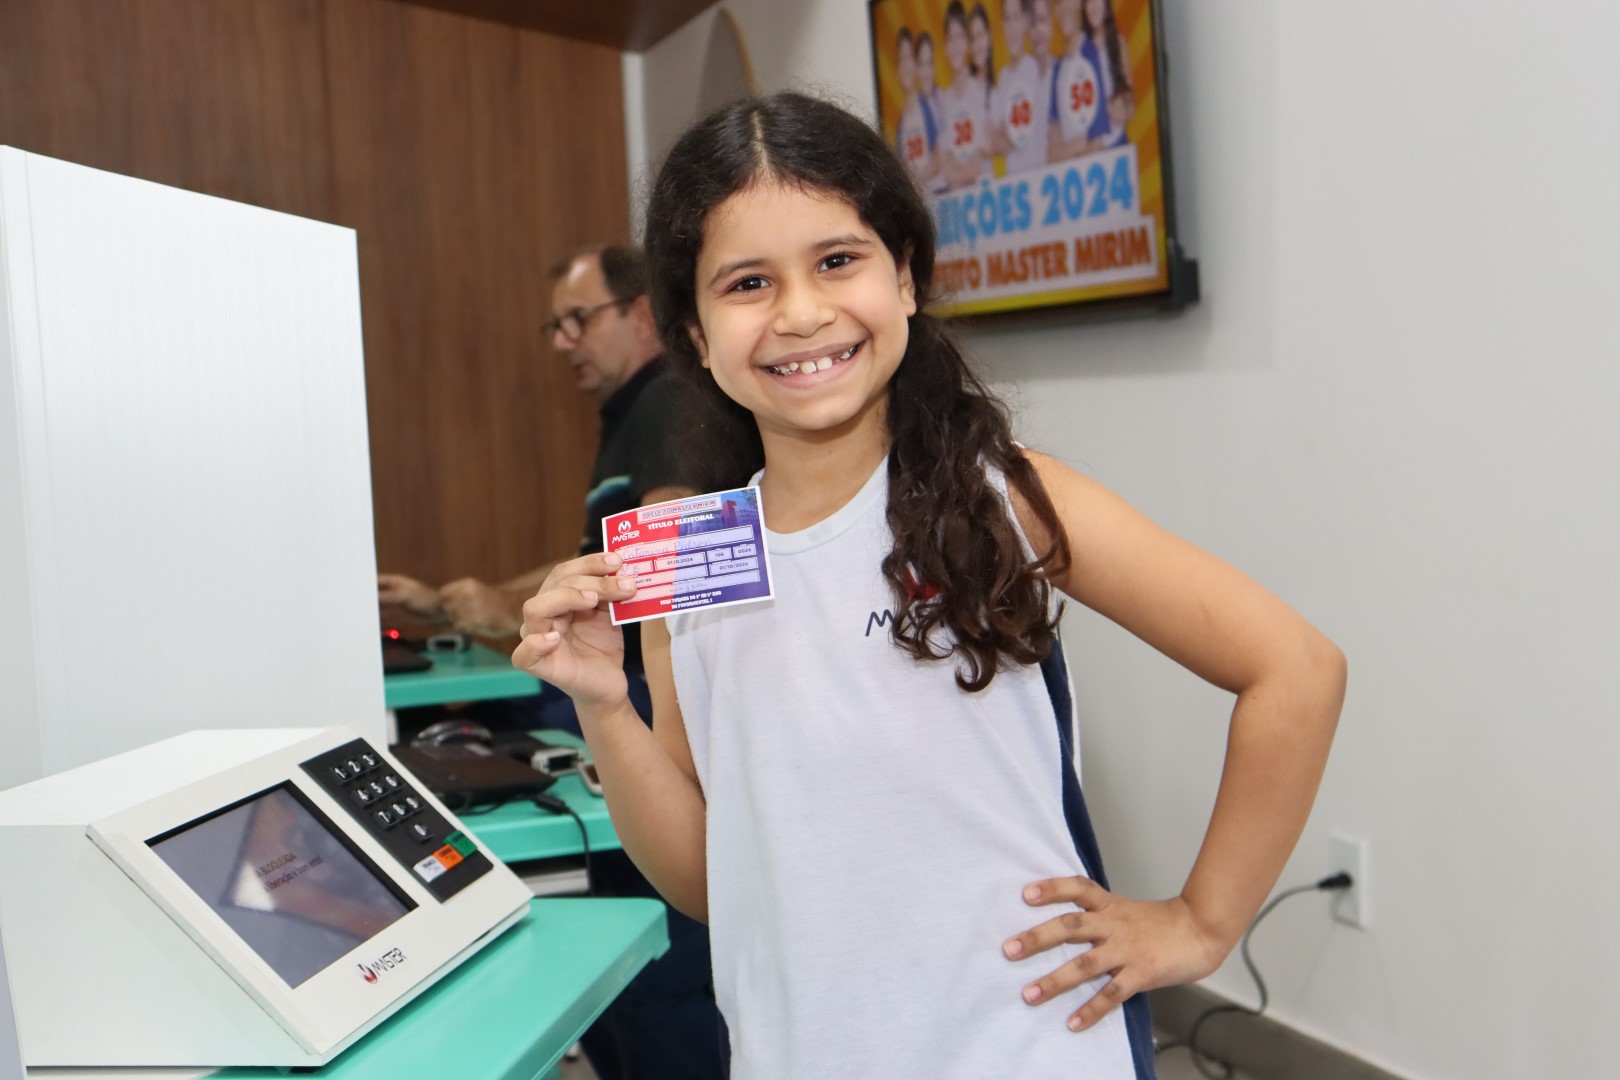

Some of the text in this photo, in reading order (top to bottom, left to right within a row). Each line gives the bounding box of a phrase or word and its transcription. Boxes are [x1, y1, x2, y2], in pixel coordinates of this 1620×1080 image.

[1070, 78, 1095, 111] 50
[1010, 100, 1032, 127] 40
[1041, 155, 1133, 226] 2024
[986, 240, 1068, 287] MASTER
[1075, 226, 1151, 274] MIRIM
[647, 513, 714, 530] TÍTULO ELEITORAL
[612, 530, 640, 544] MASTER
[334, 754, 375, 779] 1 2 3
[357, 775, 397, 801] 4 5 6
[378, 797, 418, 823] 7 8 9
[414, 824, 426, 836] 0
[371, 947, 408, 977] MASTER
